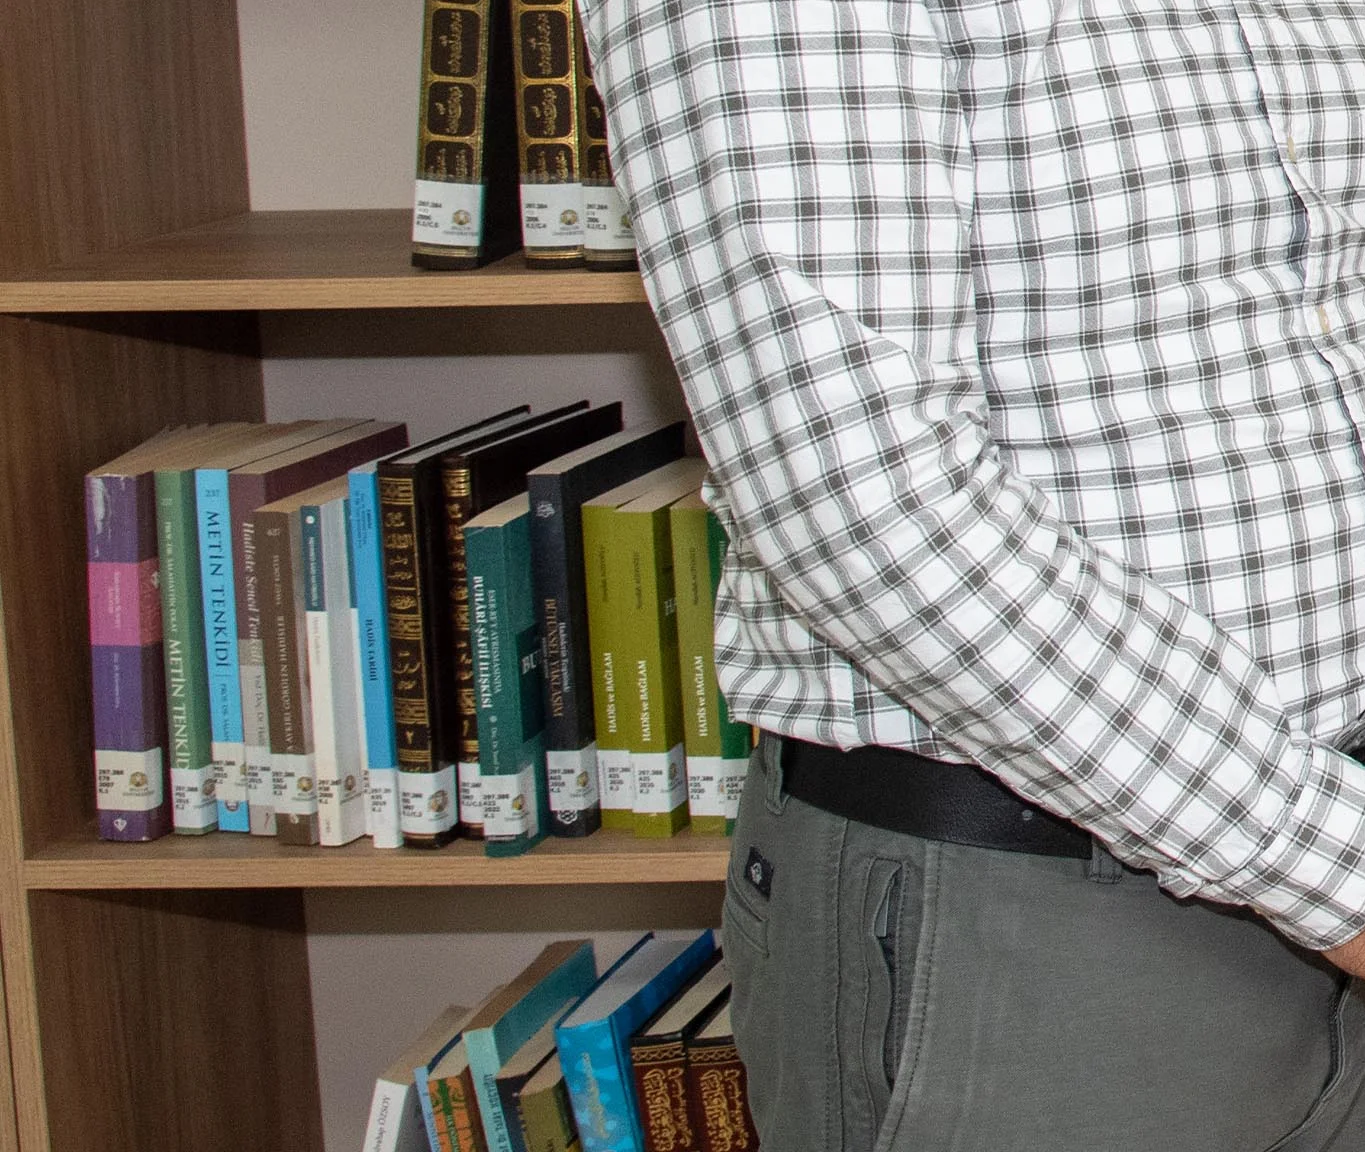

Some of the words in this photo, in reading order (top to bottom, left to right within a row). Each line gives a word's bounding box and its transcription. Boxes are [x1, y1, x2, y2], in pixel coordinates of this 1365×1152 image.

[205, 511, 224, 576] METİN
[211, 588, 231, 668] TENKİDİ
[603, 652, 615, 691] BAĞLAM
[637, 660, 648, 699] BAĞLAM
[694, 656, 704, 694] BAĞLAM
[608, 705, 617, 733] HADİS
[642, 713, 651, 741] HADİS
[699, 708, 708, 737] HADİS
